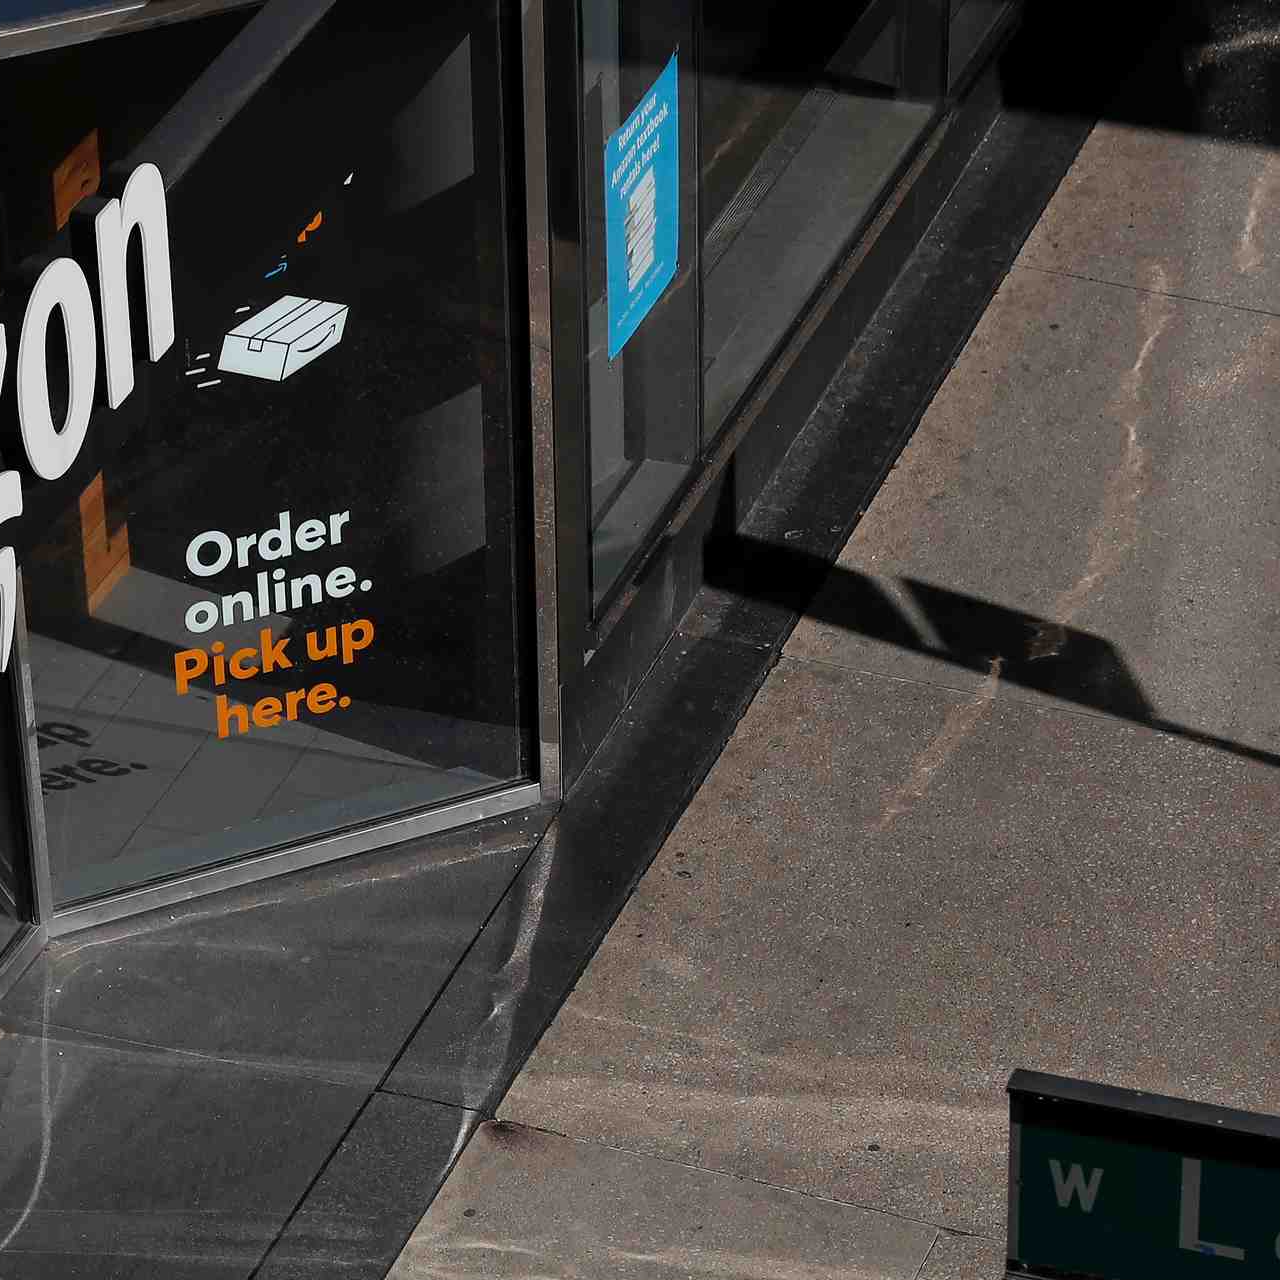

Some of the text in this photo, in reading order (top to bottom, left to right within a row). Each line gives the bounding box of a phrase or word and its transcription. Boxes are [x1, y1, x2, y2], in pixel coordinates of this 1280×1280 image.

[186, 510, 350, 577] Order
[185, 566, 372, 633] online.
[174, 619, 375, 696] Pick up
[215, 682, 352, 740] here.
[1048, 1159, 1105, 1214] W
